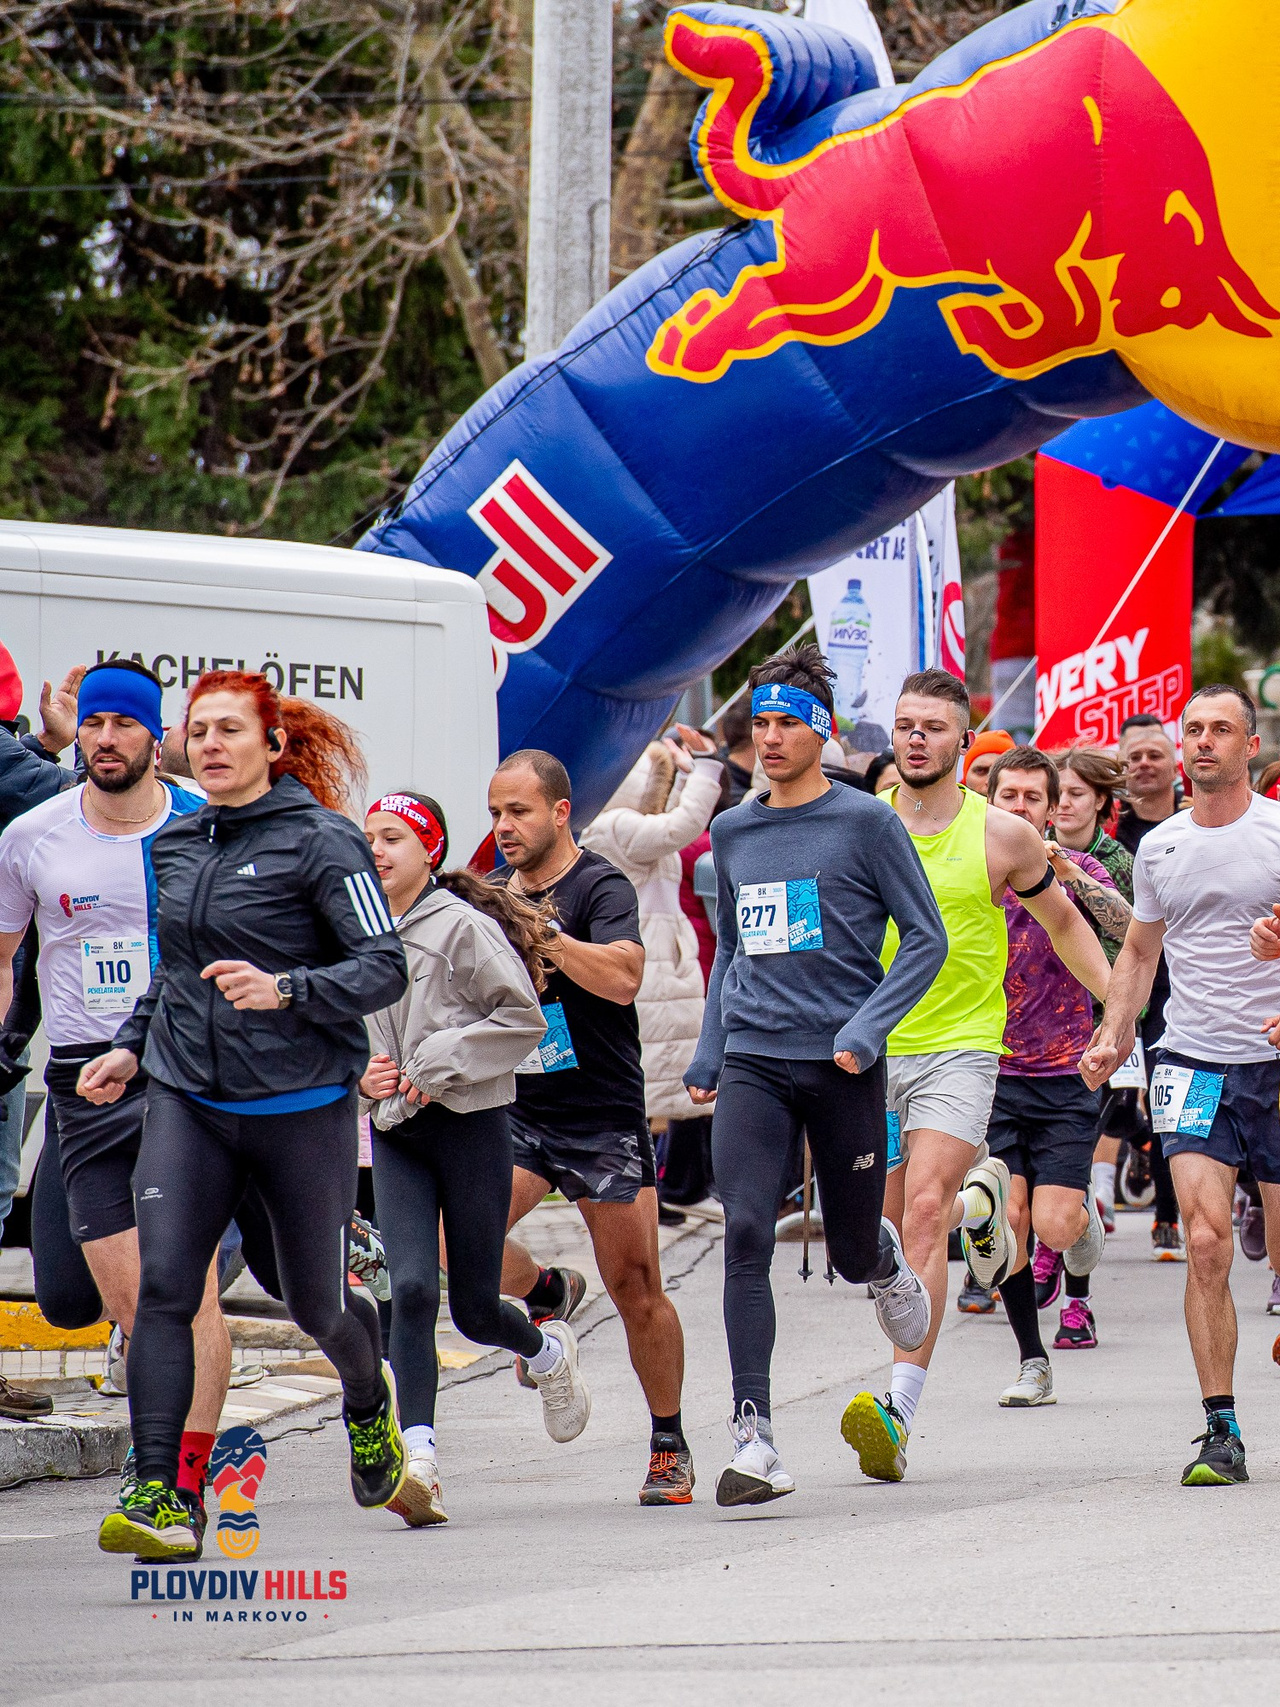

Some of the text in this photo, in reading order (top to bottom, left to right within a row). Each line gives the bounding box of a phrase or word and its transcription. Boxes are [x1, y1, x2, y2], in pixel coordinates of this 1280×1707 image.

[479, 473, 600, 675] ull
[1035, 626, 1150, 730] EVERY
[812, 703, 831, 721] EVER
[1074, 663, 1184, 747] STEP
[811, 713, 831, 728] STEP
[72, 894, 101, 905] PLOVDIV
[757, 887, 767, 896] 8K
[74, 903, 92, 912] HILLS
[741, 904, 777, 929] 277
[113, 941, 124, 950] 8K
[95, 959, 132, 984] 110
[1154, 1084, 1174, 1107] 105
